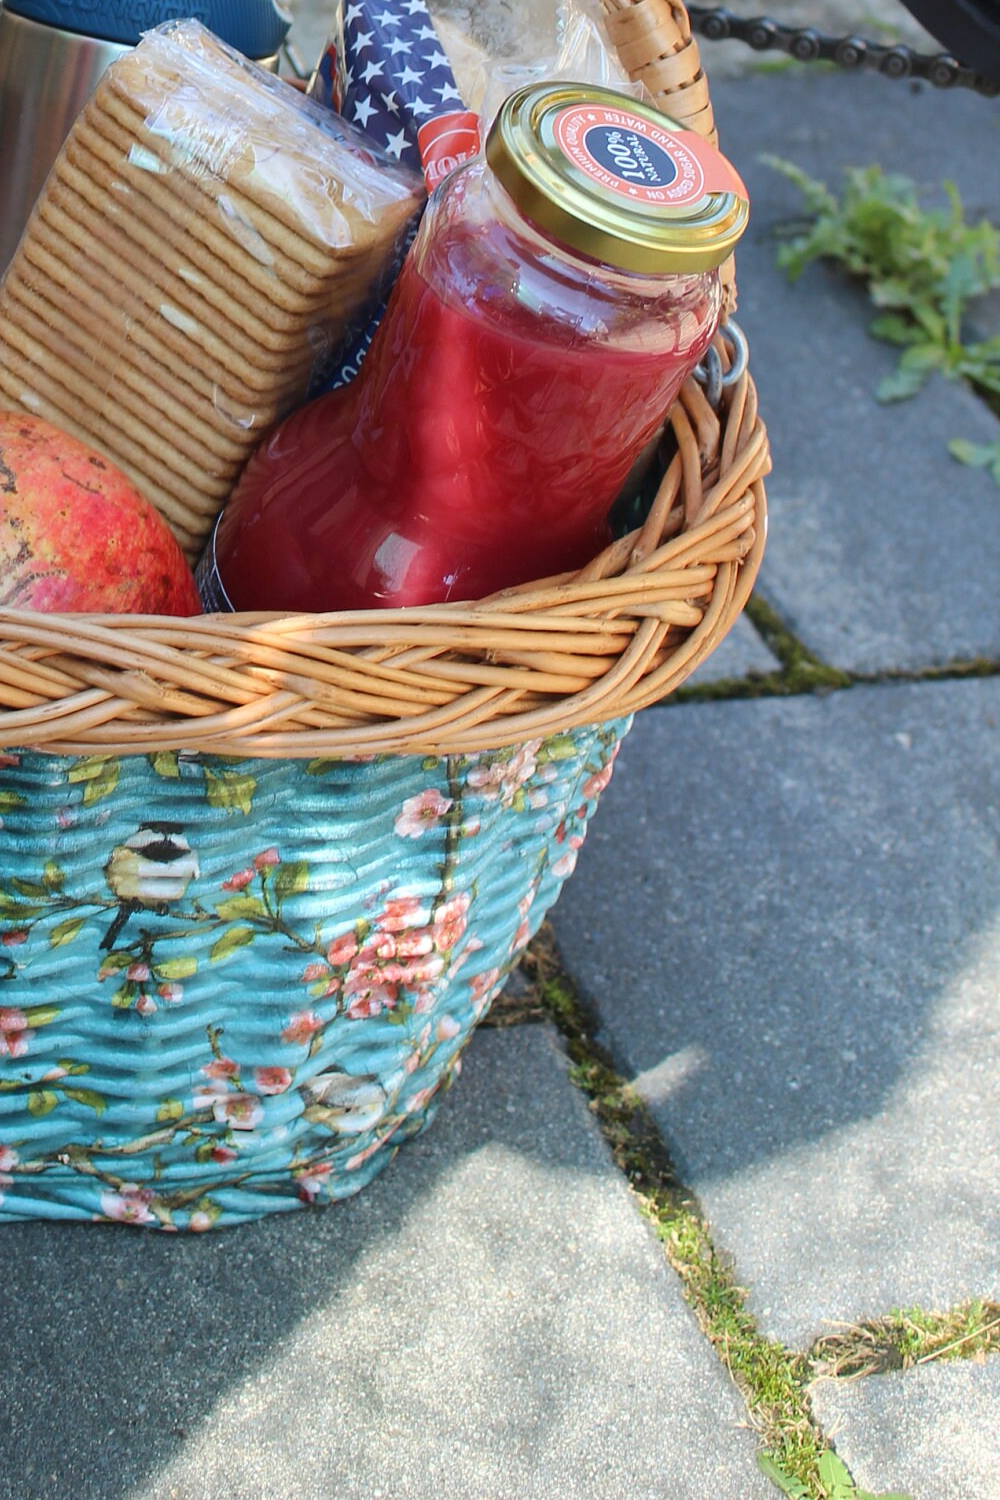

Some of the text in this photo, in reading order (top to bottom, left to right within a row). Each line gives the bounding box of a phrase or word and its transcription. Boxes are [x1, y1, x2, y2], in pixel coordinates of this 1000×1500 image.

[603, 112, 647, 132] WATER
[650, 129, 676, 149] AND
[565, 113, 620, 188] PREMIUM QUALITY
[605, 131, 645, 180] 100%
[626, 134, 662, 182] NATURAL
[673, 149, 696, 181] SUGAR
